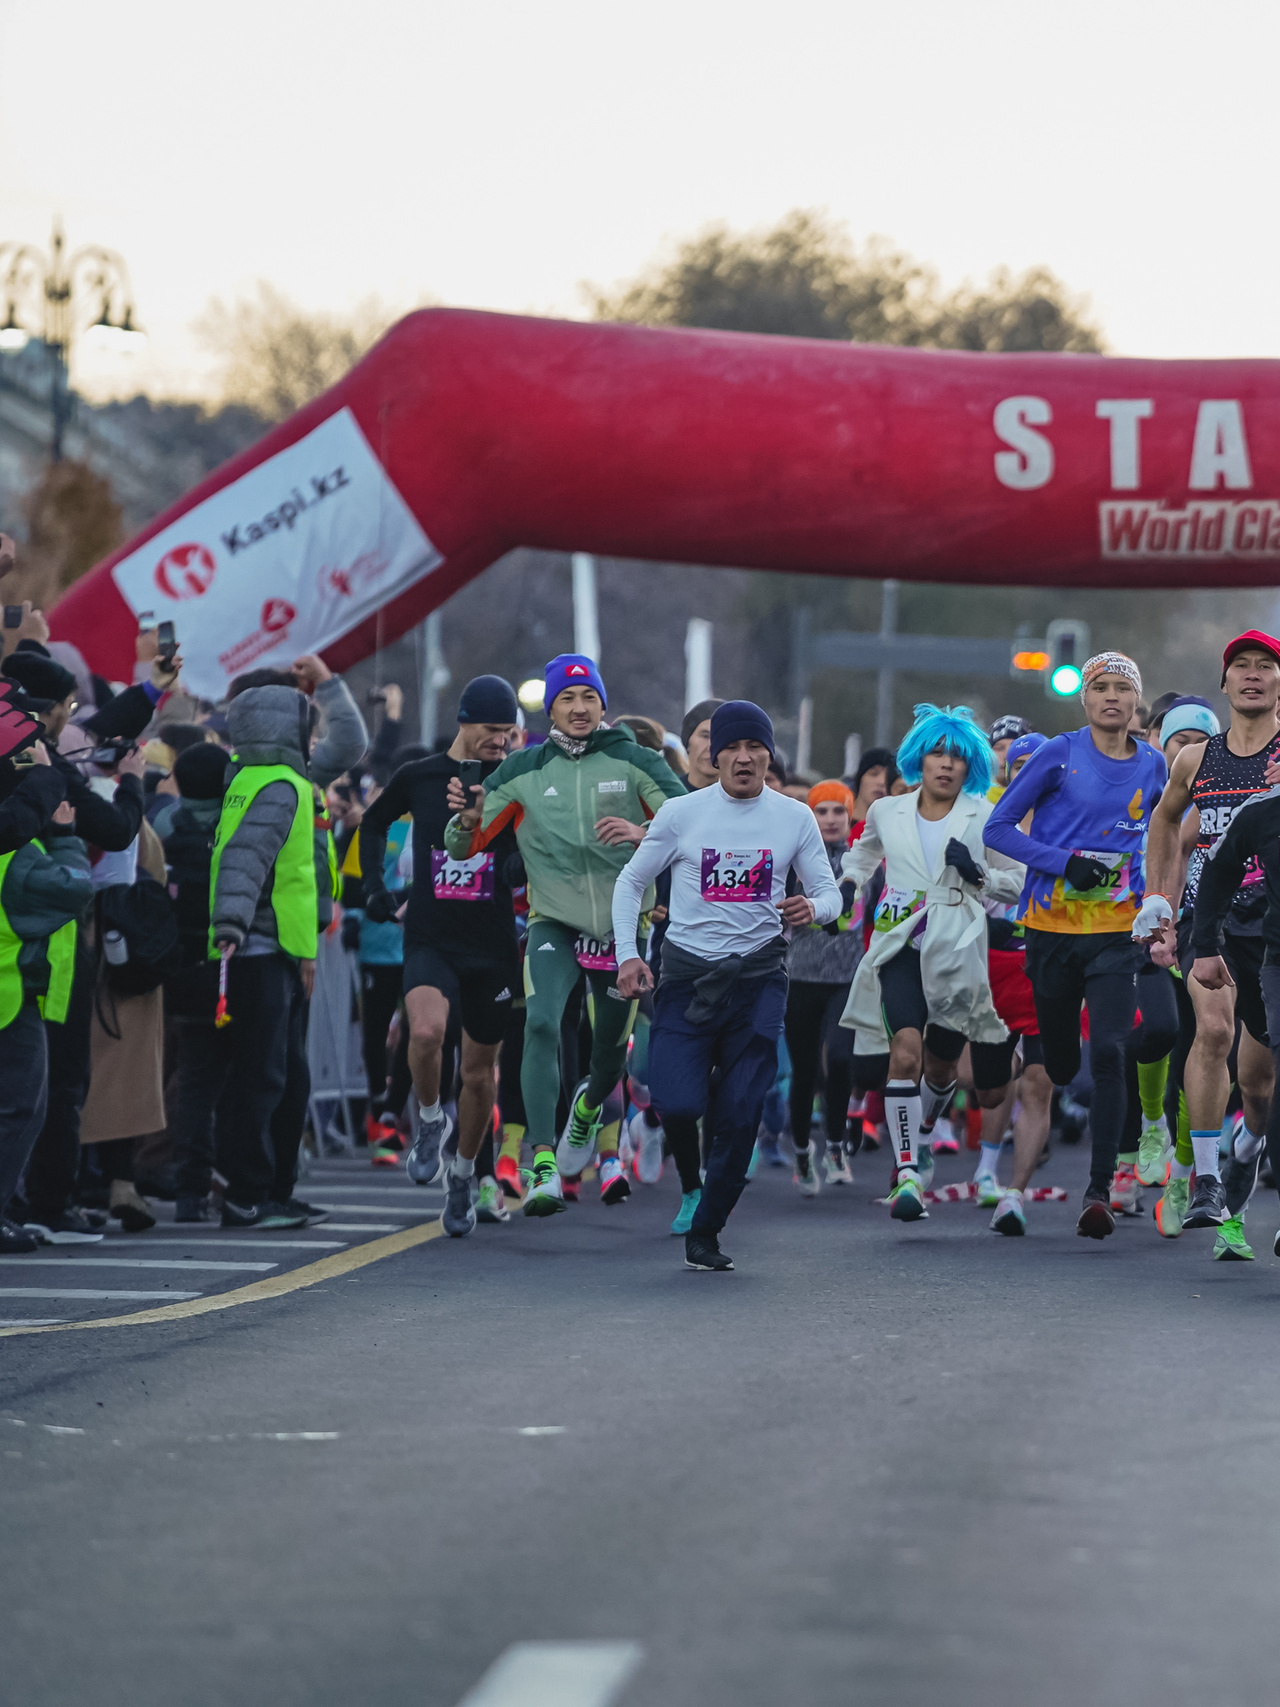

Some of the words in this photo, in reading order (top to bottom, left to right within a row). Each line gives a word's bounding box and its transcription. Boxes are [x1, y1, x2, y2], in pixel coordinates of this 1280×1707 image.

[220, 465, 351, 556] Kaspi.kz
[1106, 504, 1228, 553] World
[706, 869, 764, 888] 1342
